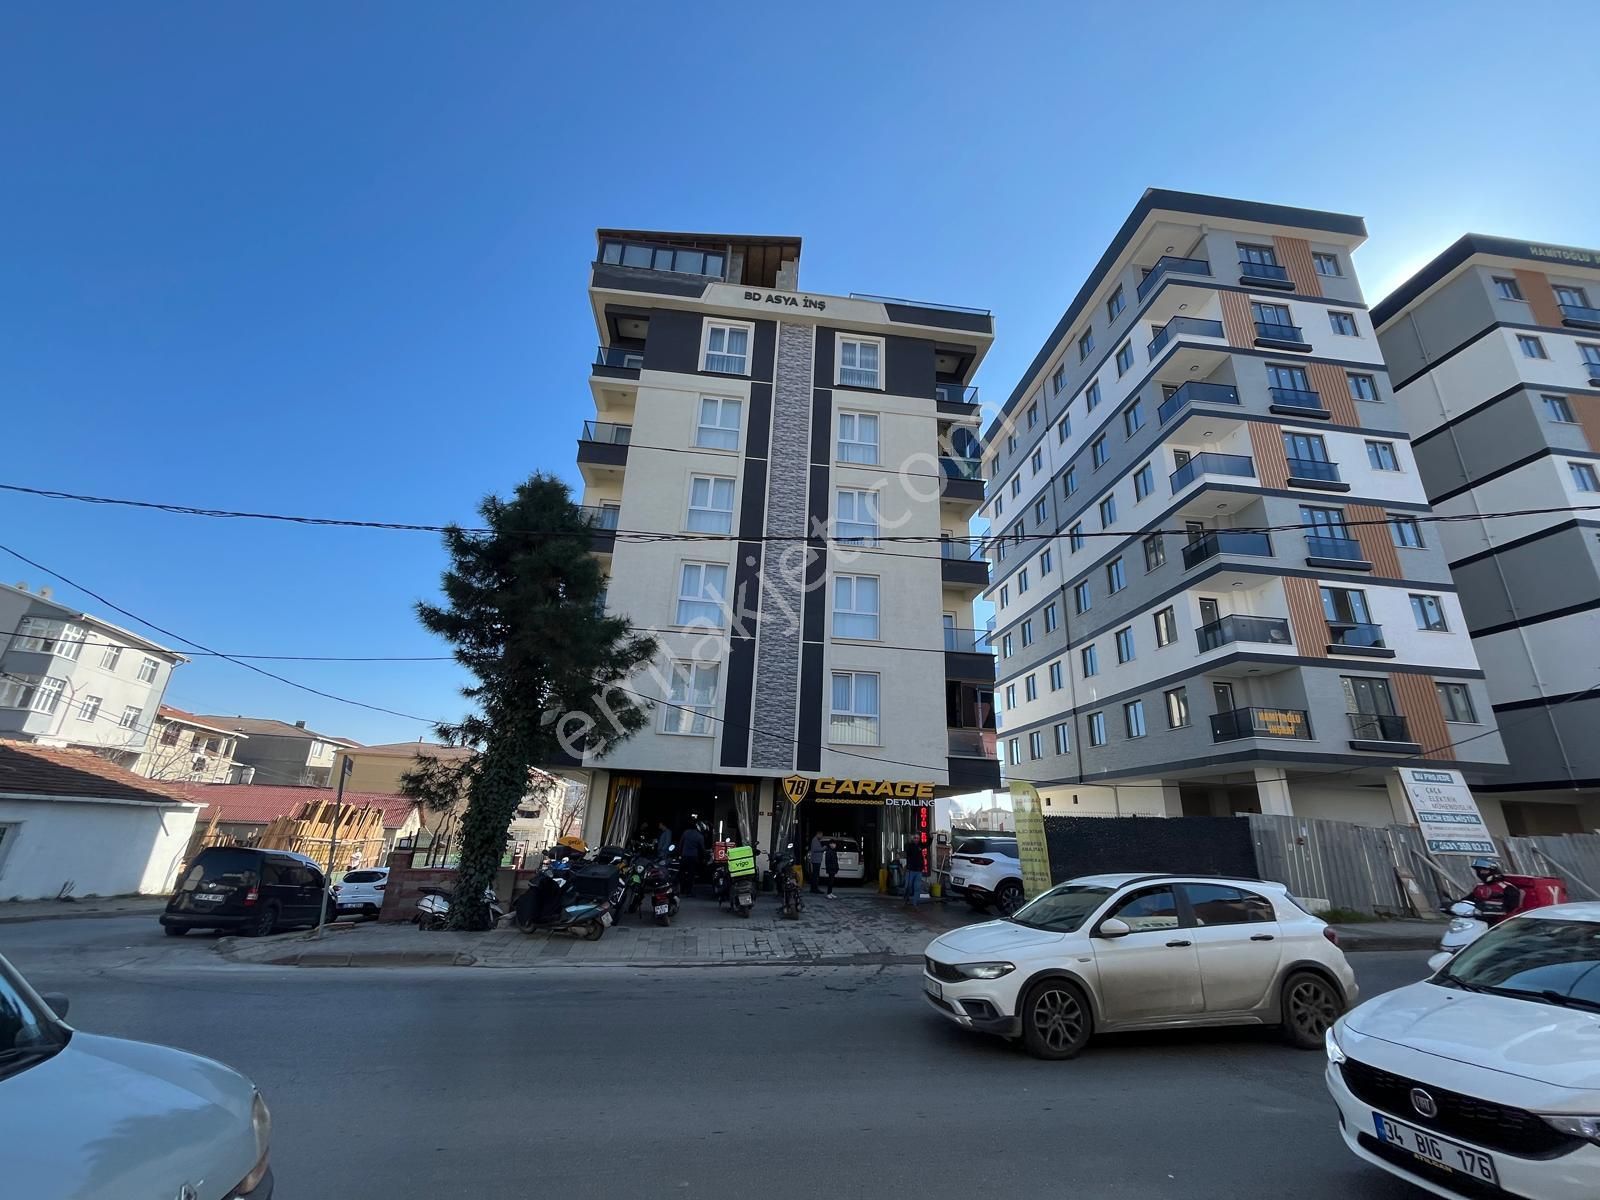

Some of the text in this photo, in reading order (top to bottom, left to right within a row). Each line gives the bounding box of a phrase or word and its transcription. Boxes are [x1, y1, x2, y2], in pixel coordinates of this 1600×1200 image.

[744, 291, 826, 311] BD ASYA İNŞ
[815, 777, 935, 798] GARAGE
[885, 798, 935, 807] DETAILING
[1383, 1120, 1404, 1145] 34
[1414, 1132, 1442, 1161] BIG
[1456, 1150, 1492, 1180] 176
